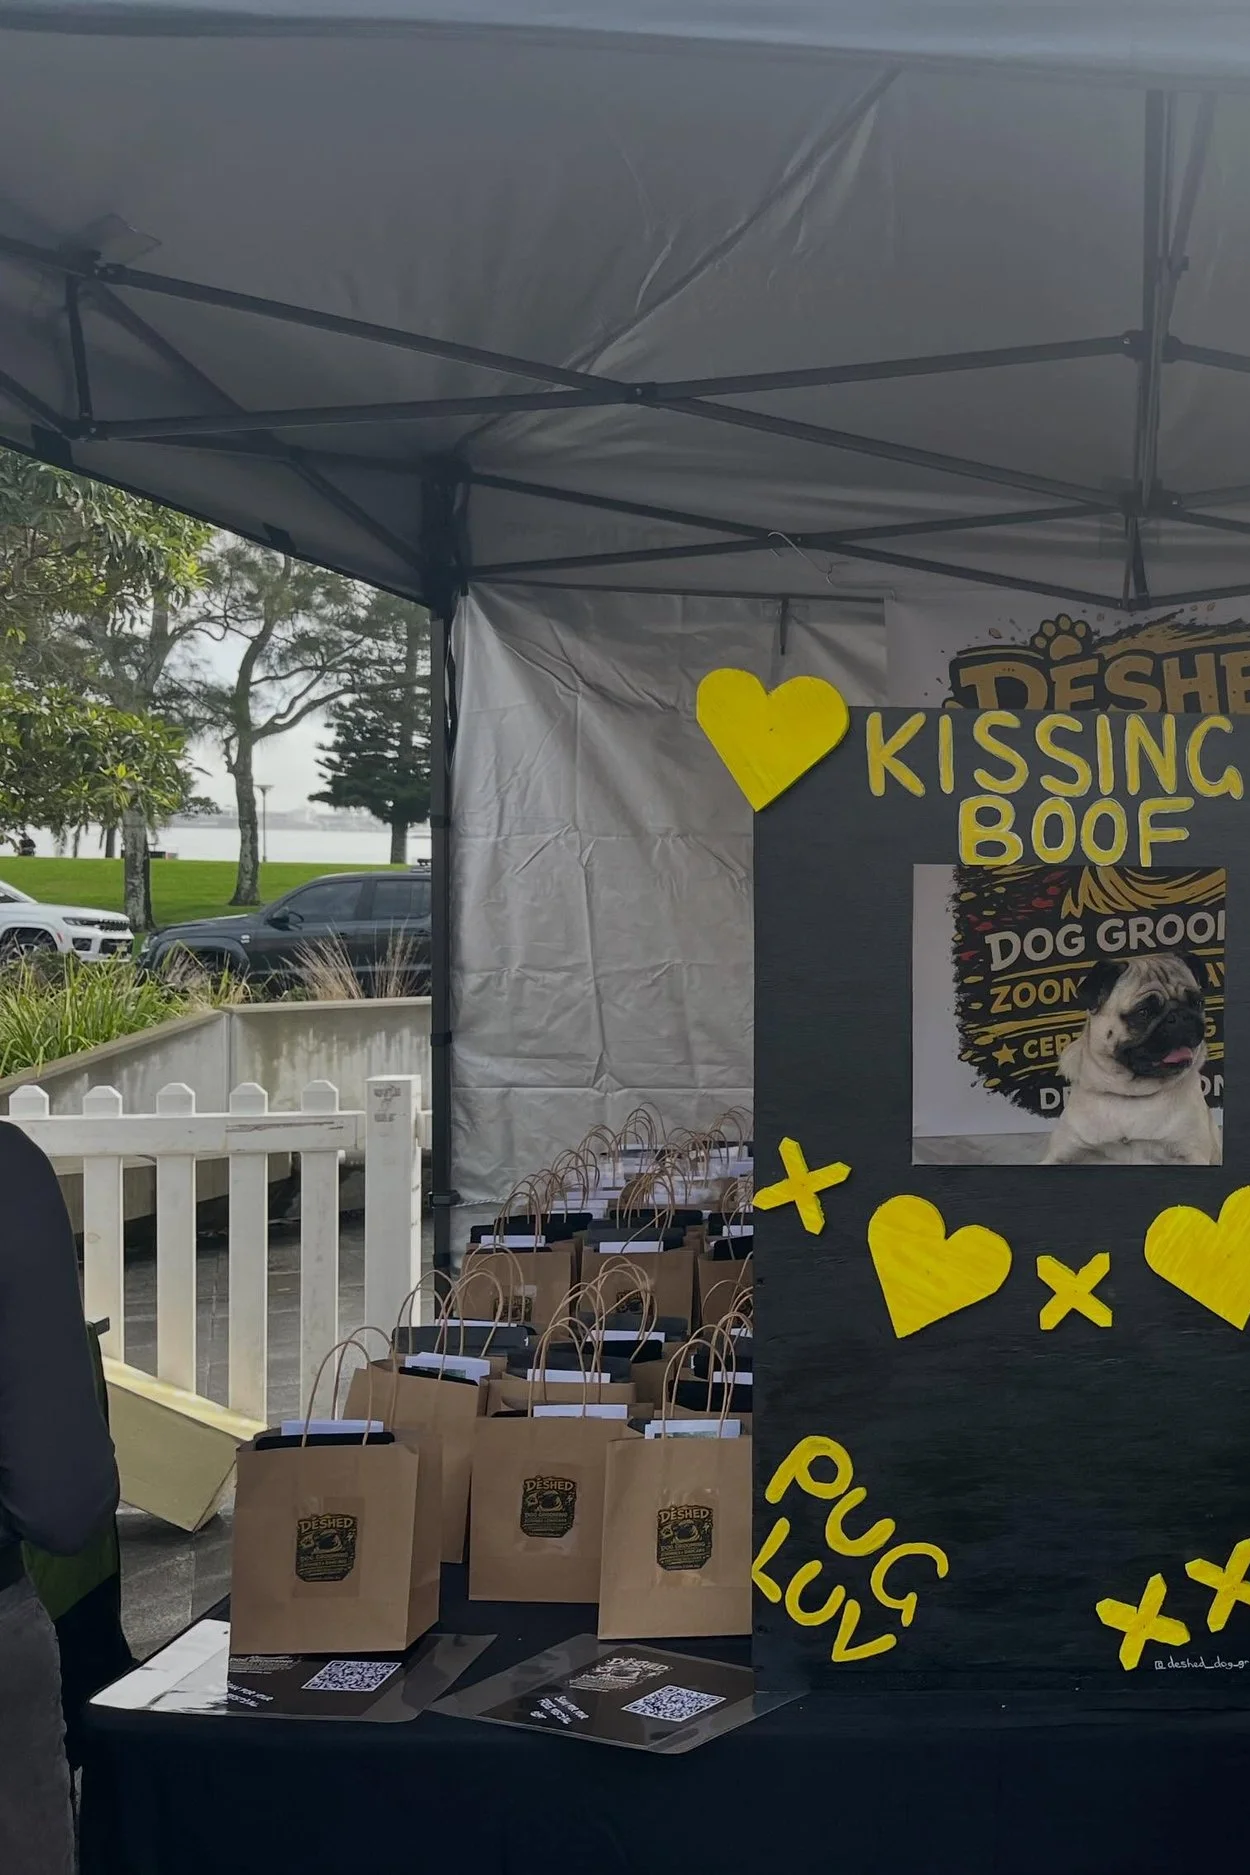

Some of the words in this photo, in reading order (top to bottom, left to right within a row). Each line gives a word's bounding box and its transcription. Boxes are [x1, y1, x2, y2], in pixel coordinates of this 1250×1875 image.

[866, 710, 1243, 800] KISSING
[958, 795, 1195, 867] BOOF
[985, 923, 1086, 971] DOG
[1096, 910, 1225, 952] GROO
[525, 1480, 574, 1492] DESHED
[659, 1508, 710, 1523] DESHED
[300, 1518, 353, 1534] DESHED
[765, 1435, 949, 1627] PUG
[751, 1517, 897, 1662] LUV
